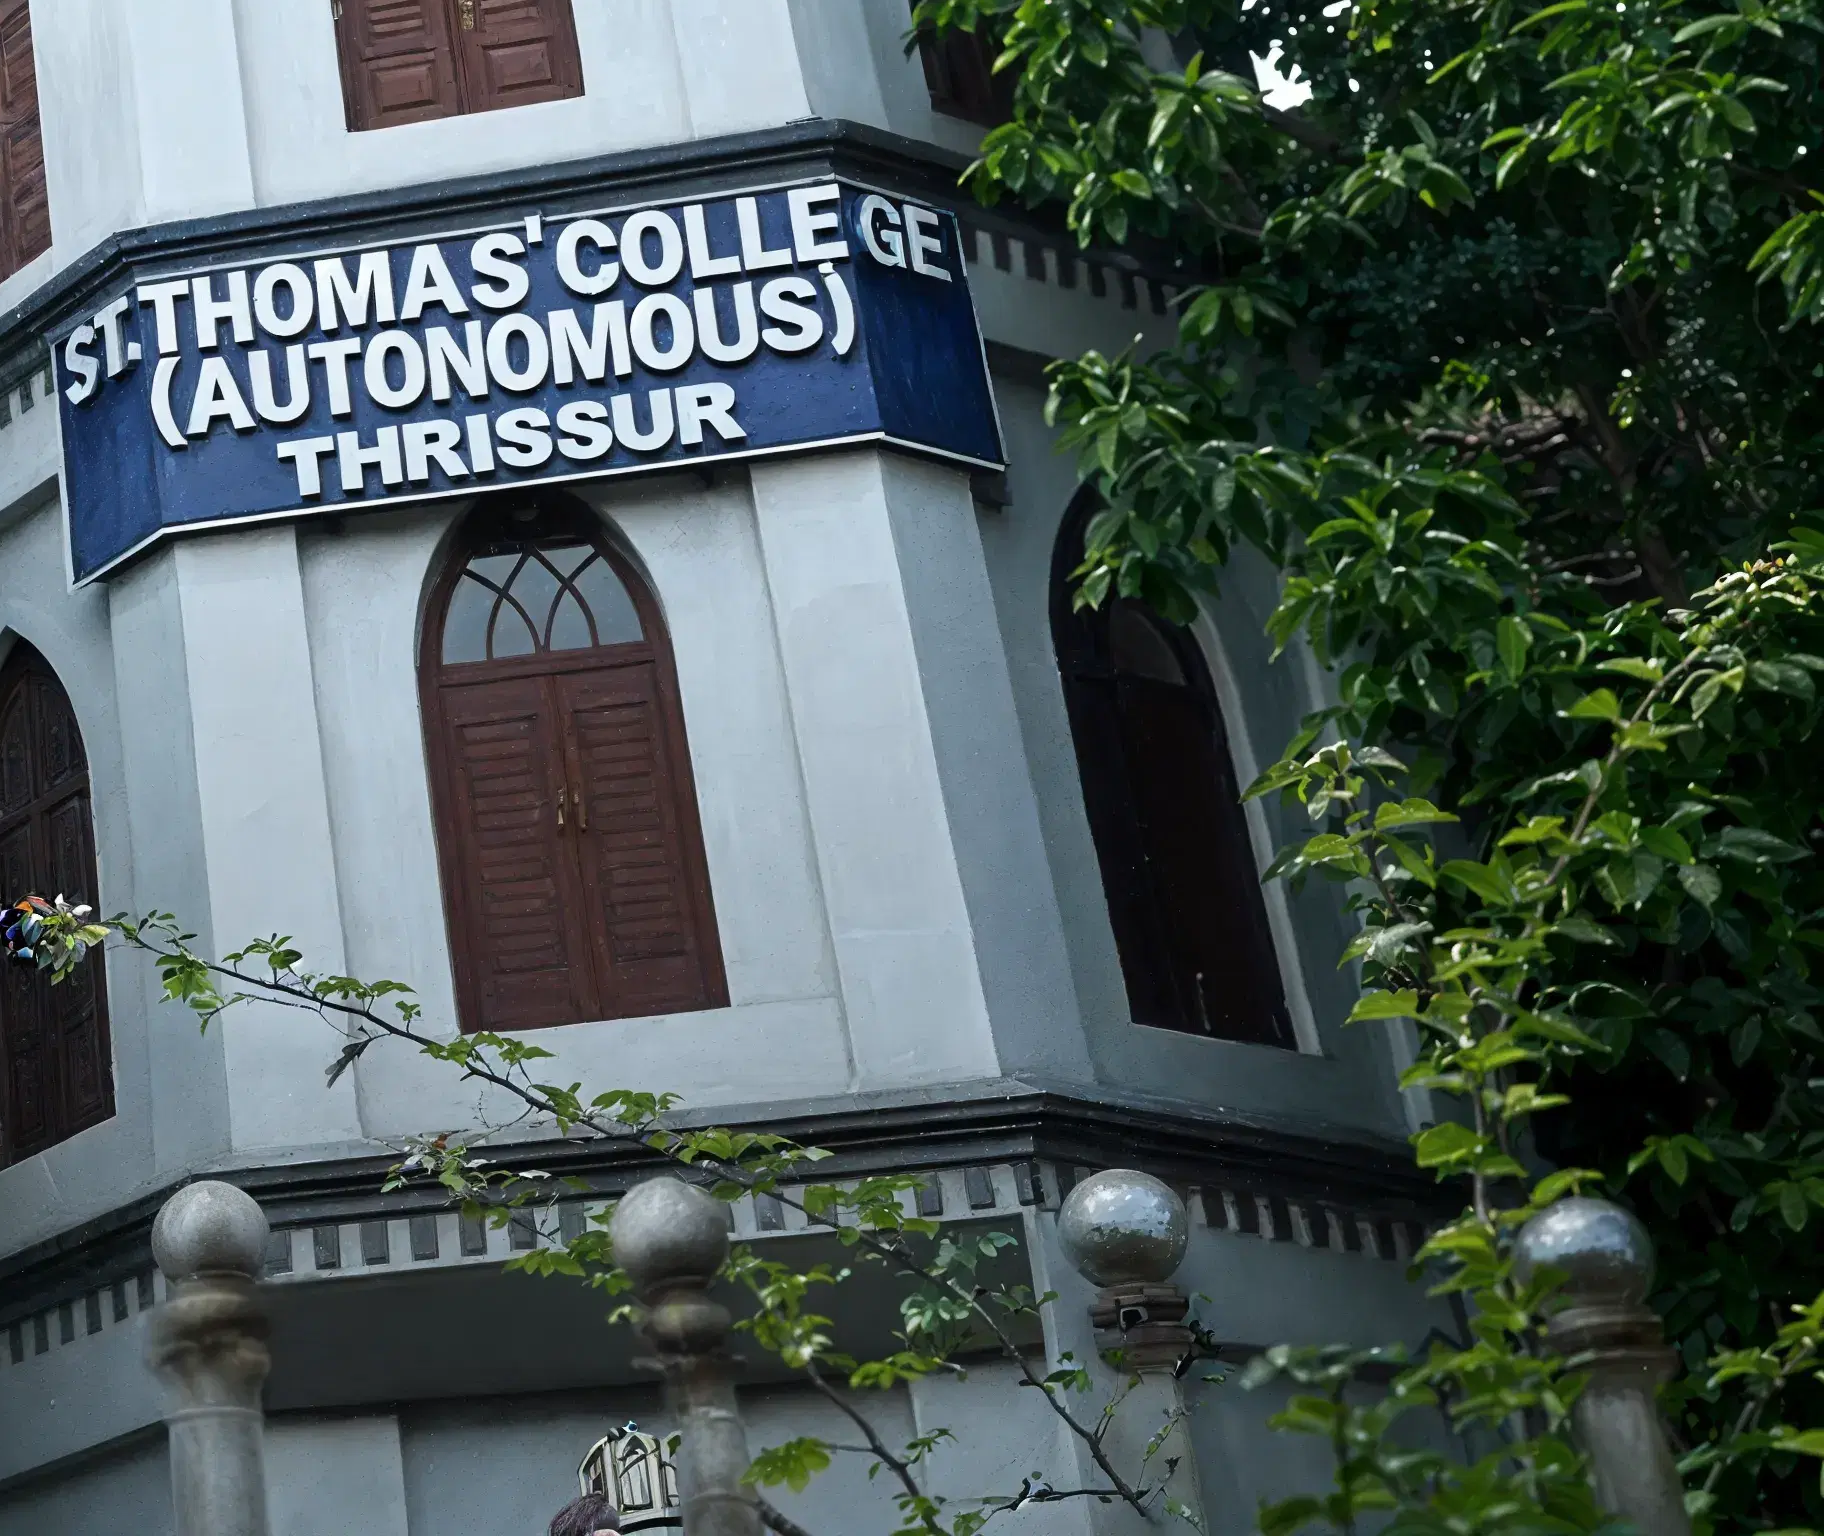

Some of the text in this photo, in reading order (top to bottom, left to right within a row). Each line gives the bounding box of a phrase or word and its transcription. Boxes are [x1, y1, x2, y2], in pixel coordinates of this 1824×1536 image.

[65, 183, 952, 405] ST. THOMAS' COLLEGE
[151, 262, 855, 447] (AUTONOMOUS)
[277, 381, 748, 498] THRISSUR
